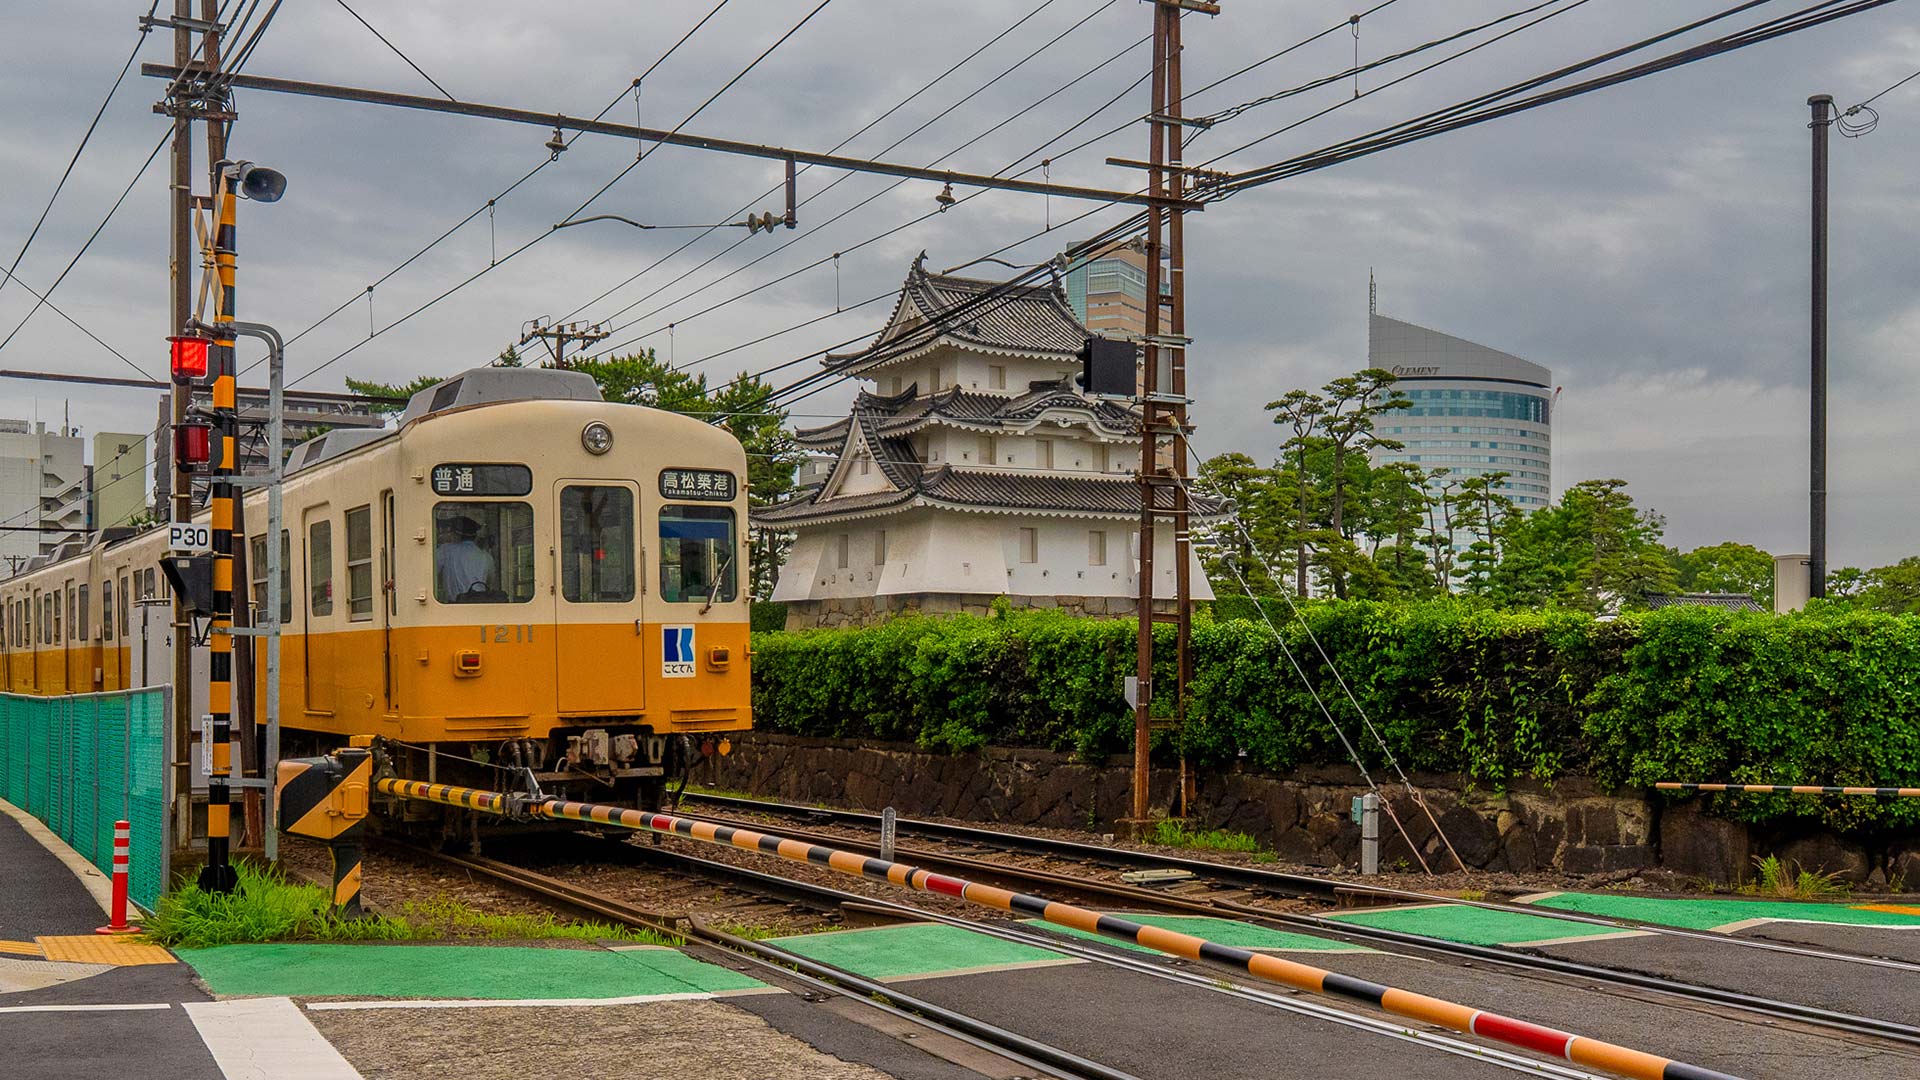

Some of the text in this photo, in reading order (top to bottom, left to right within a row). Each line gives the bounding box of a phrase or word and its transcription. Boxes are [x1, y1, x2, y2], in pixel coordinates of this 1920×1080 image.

[1391, 365, 1440, 376] CLEMENT
[435, 467, 473, 491] 普通
[663, 472, 728, 490] 高松築港
[663, 488, 728, 497] Takamatsu-Chikko
[170, 527, 208, 546] P30
[480, 624, 533, 643] 1211
[664, 664, 694, 674] ことでん
